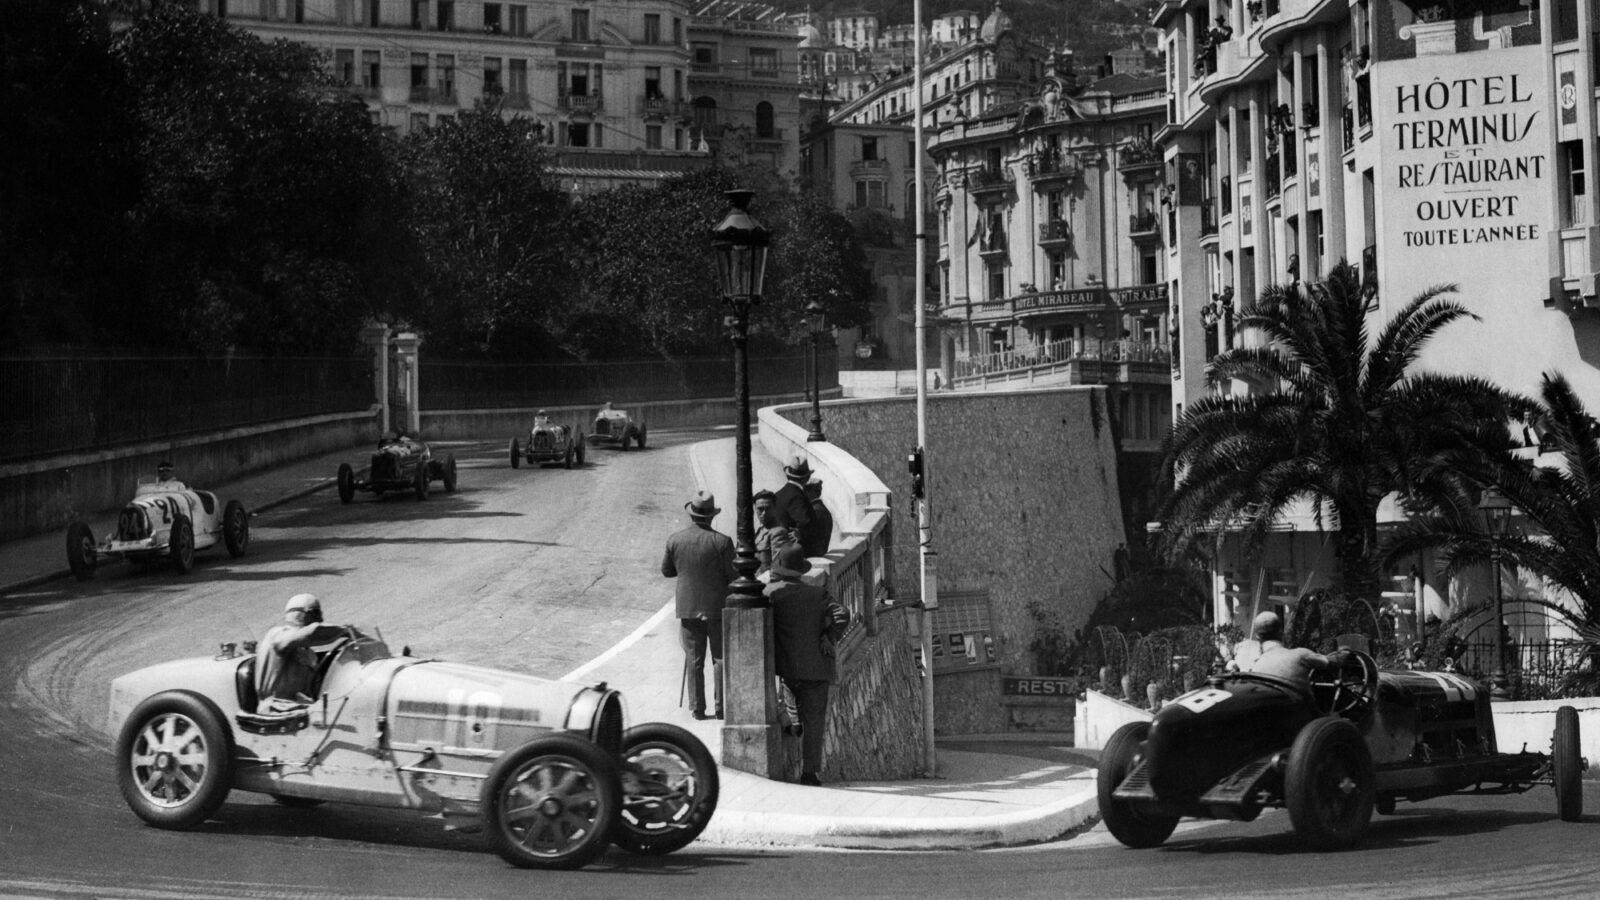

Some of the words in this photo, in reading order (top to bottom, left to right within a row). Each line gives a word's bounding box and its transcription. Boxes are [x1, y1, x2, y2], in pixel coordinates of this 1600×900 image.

[1396, 74, 1533, 114] HÔTEL
[1393, 110, 1541, 150] TERMINUS
[1444, 147, 1484, 159] ET
[1398, 155, 1545, 188] RESTAURANT
[1416, 195, 1519, 221] OUVERT
[1403, 229, 1459, 247] TOUTE
[1463, 223, 1540, 244] L'ANNÉE
[1038, 292, 1094, 306] MIRABEAU
[1120, 286, 1169, 302] MIRABE
